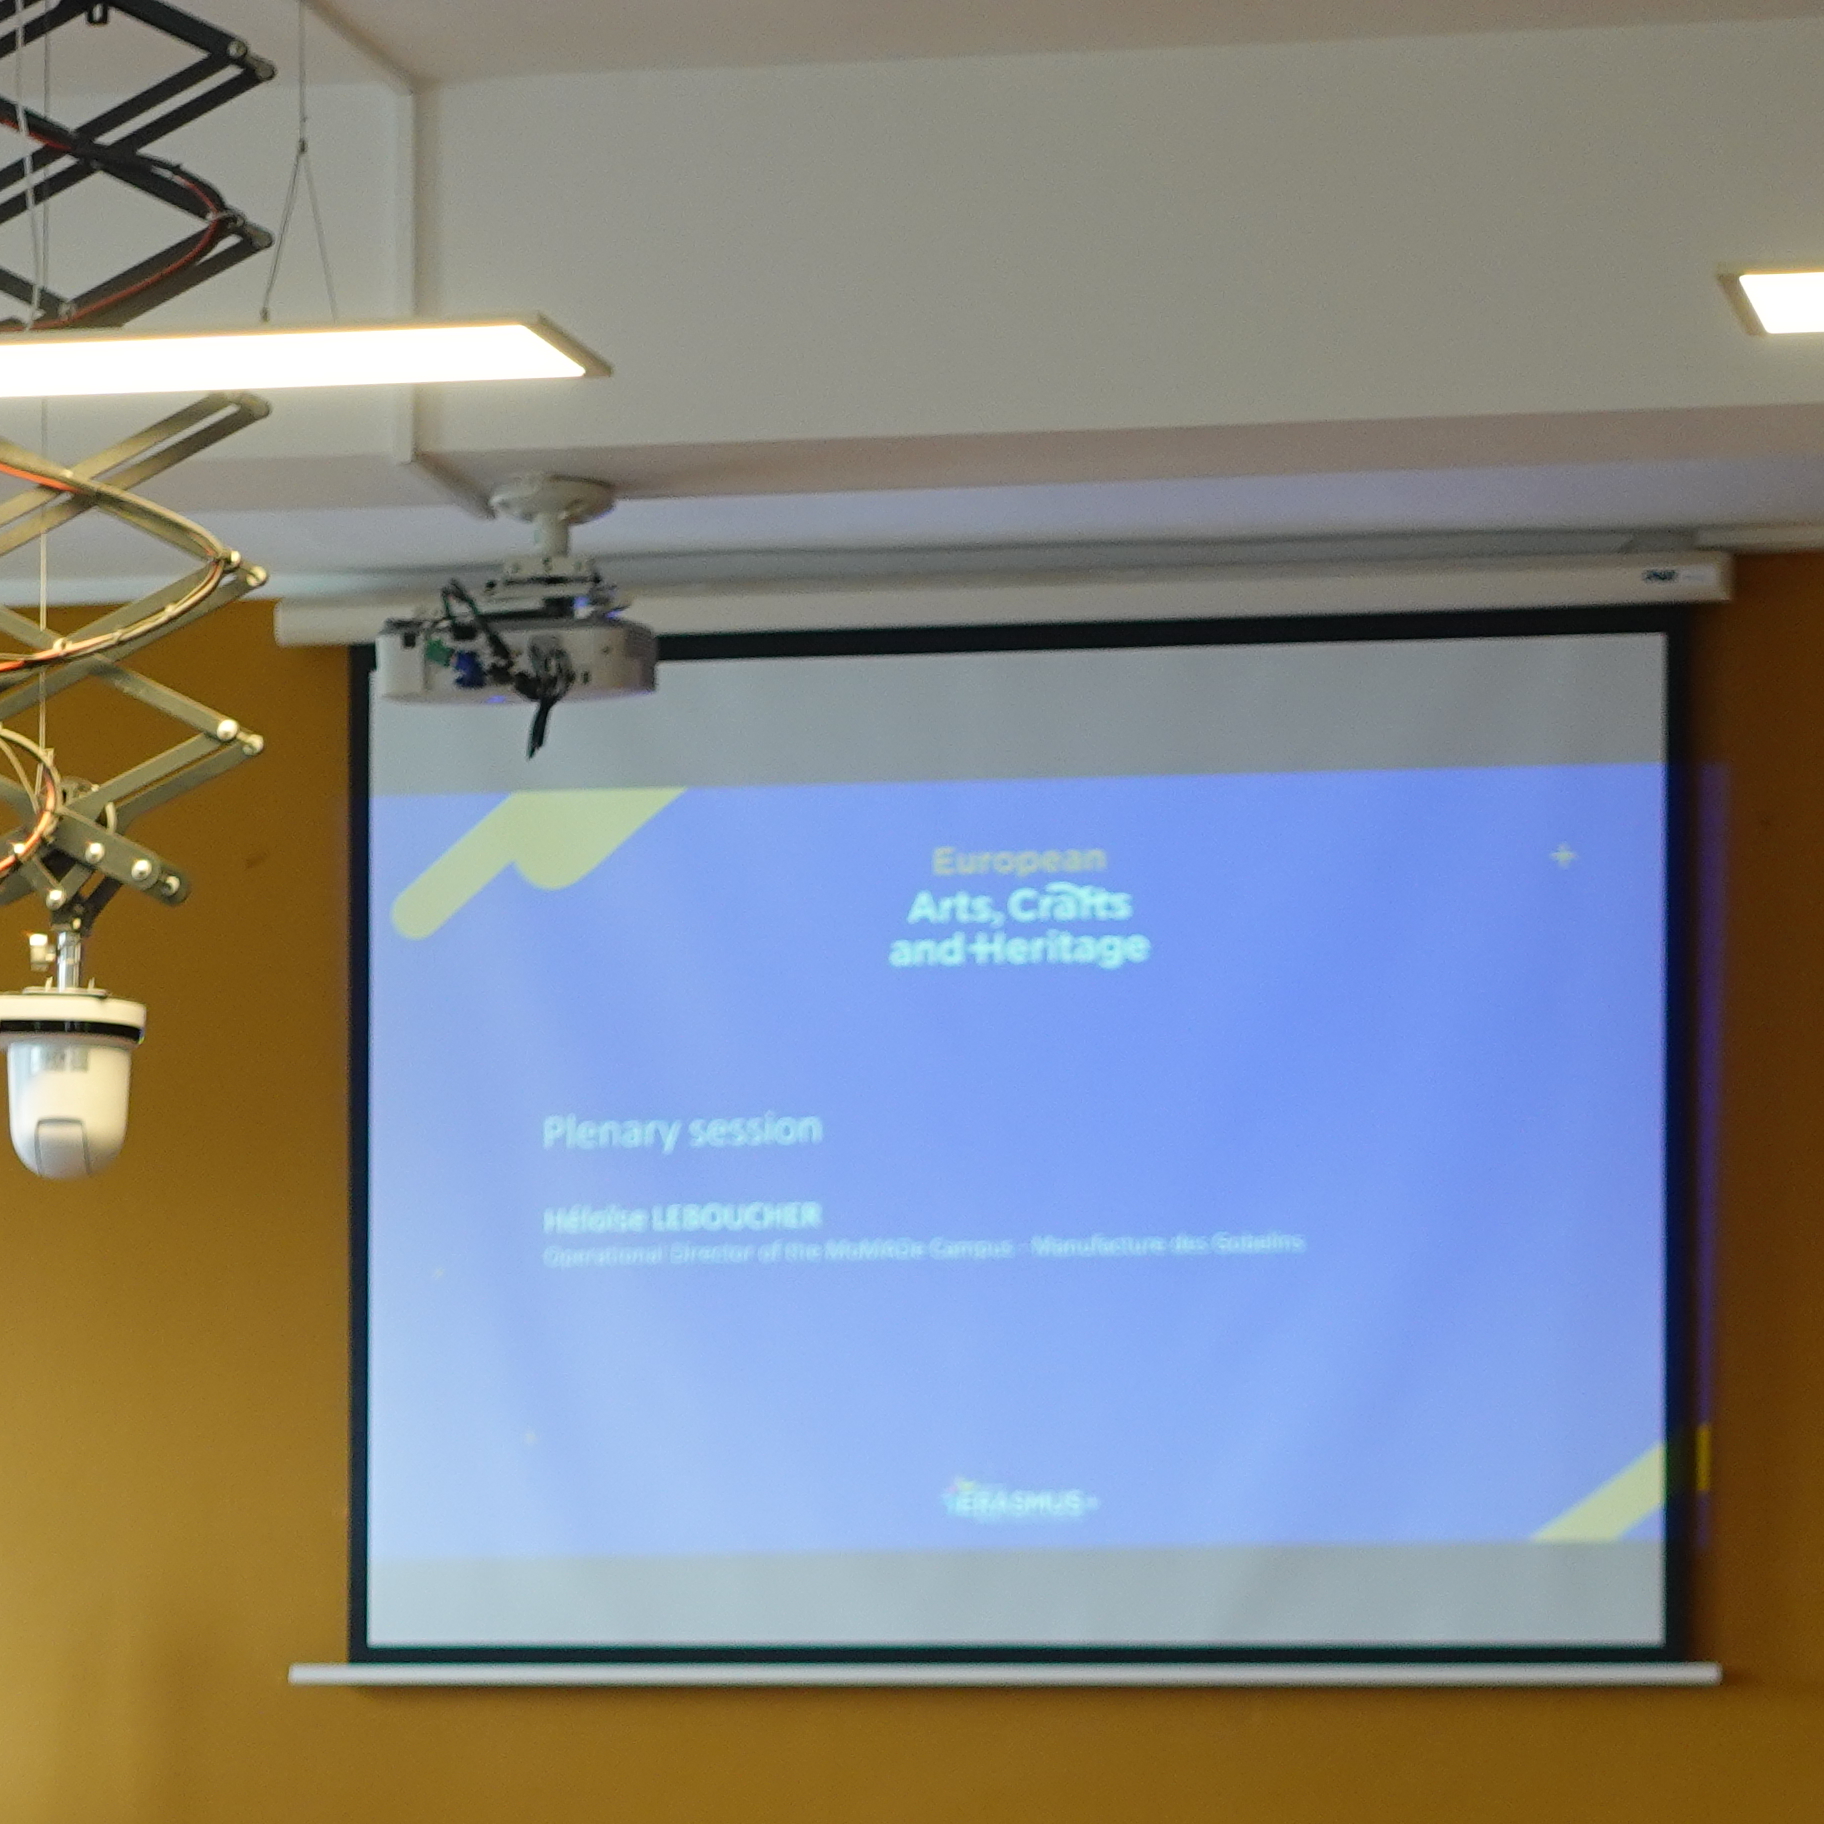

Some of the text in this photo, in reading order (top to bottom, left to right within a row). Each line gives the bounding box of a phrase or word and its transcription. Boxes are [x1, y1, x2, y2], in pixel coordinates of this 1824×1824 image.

[932, 847, 1107, 877] European
[906, 882, 1133, 928] Arts, Crafts
[888, 929, 1152, 970] and Heritage
[543, 1109, 824, 1155] Plenary session
[651, 1201, 823, 1231] LEBOUCHER
[543, 1245, 663, 1269] Operational
[670, 1241, 753, 1264] Director
[758, 1240, 783, 1263] of
[784, 1239, 823, 1262] the
